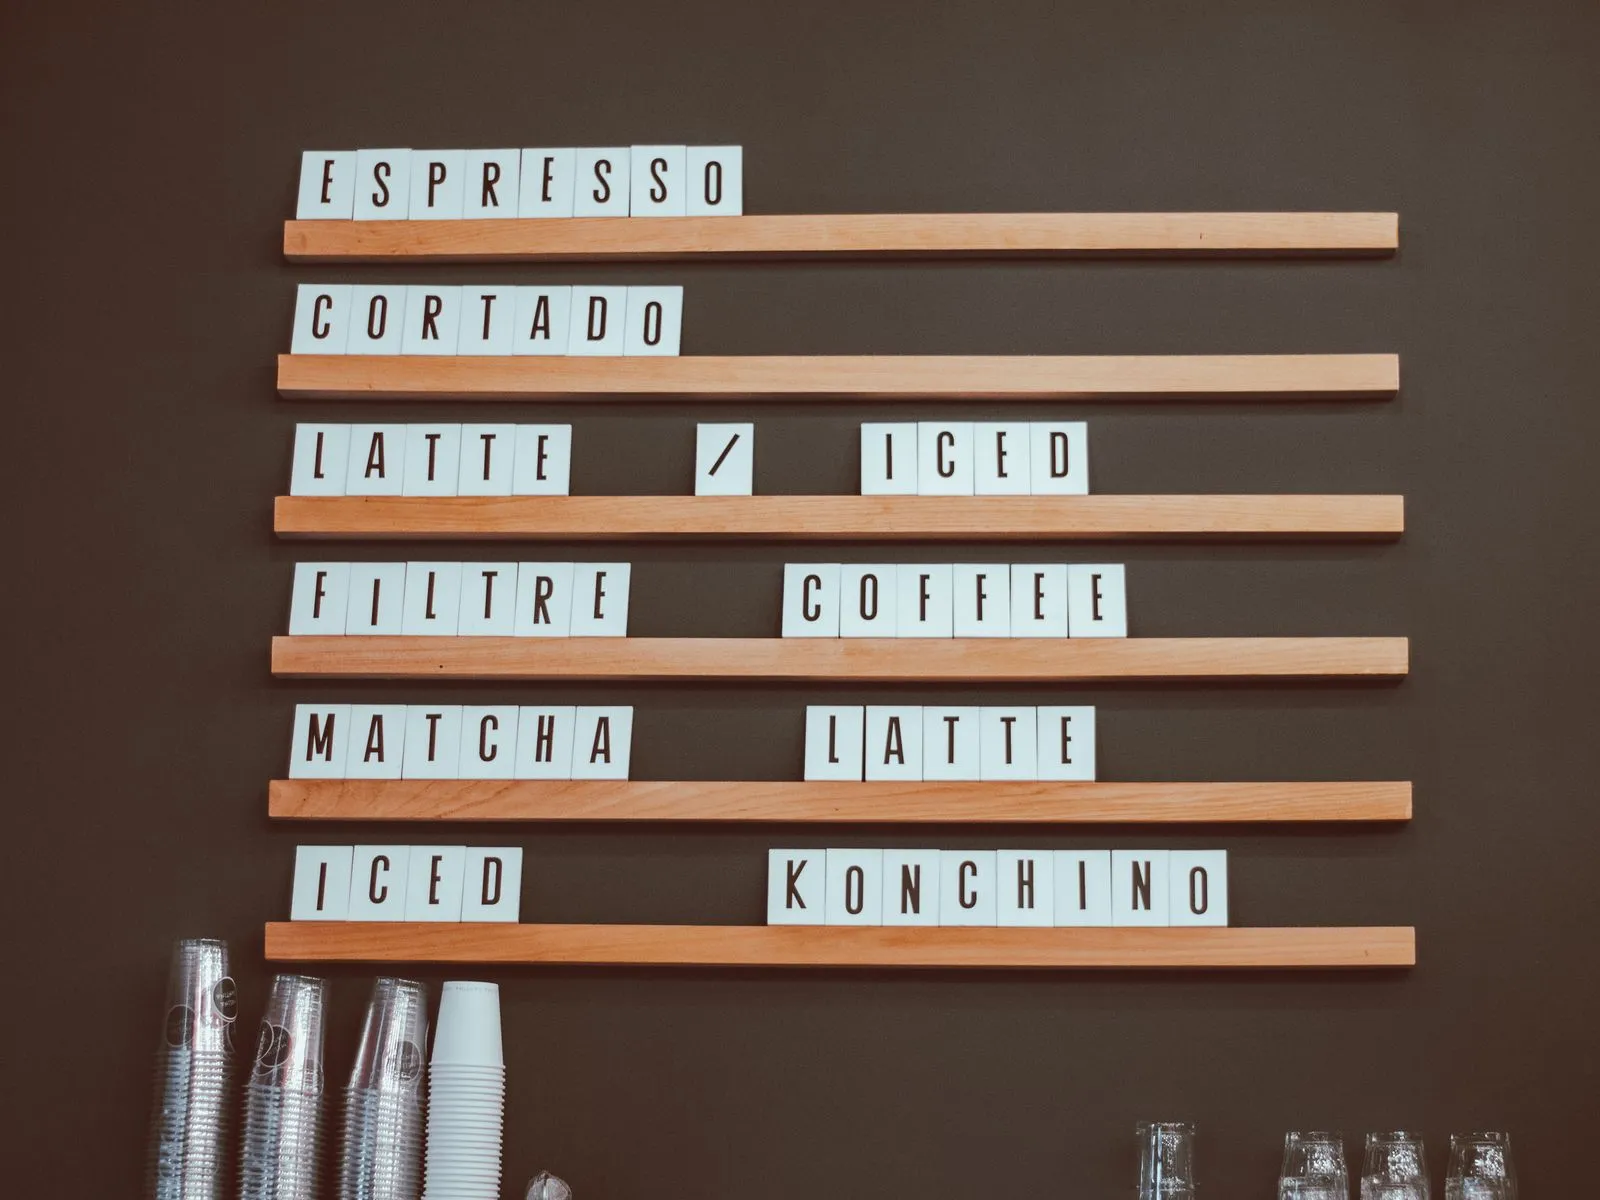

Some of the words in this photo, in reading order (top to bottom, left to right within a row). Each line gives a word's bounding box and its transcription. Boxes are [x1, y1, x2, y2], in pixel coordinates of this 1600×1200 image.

[320, 157, 722, 208] ESPRESSO
[312, 294, 662, 346] CORTADO
[313, 431, 550, 481] LATTE
[708, 433, 740, 476] /
[886, 431, 1070, 480] ICED
[313, 571, 608, 626] FILTRE
[802, 573, 1105, 622] COFFEE
[306, 713, 612, 764] MATCHA
[828, 715, 1074, 765] LATTE
[316, 855, 504, 911] ICED
[786, 859, 1209, 915] KONCHINO
